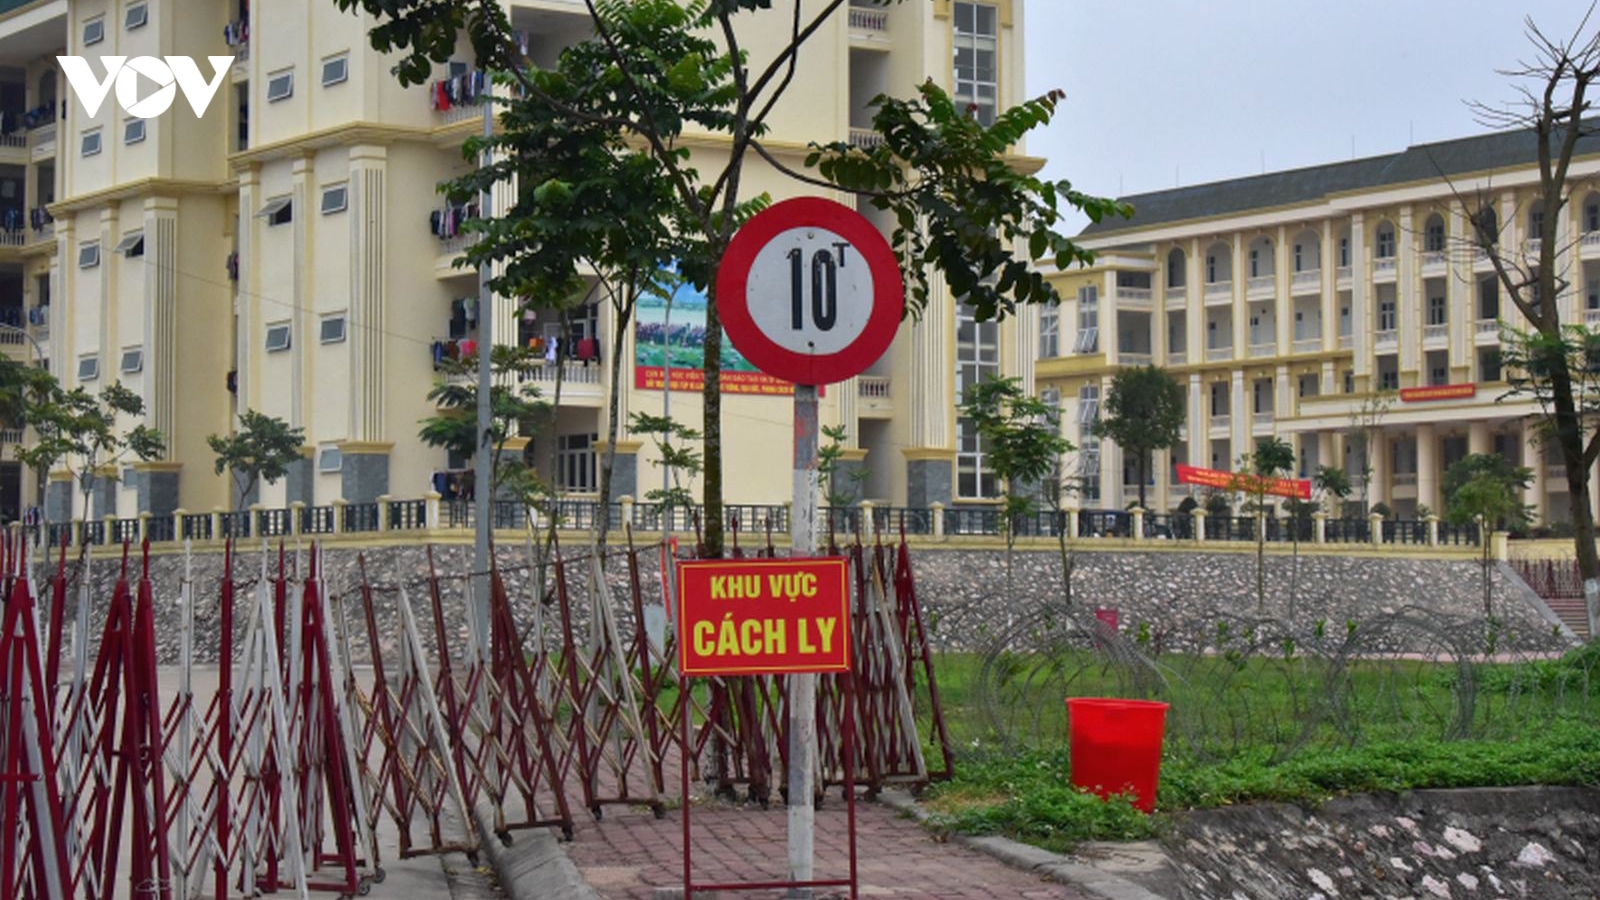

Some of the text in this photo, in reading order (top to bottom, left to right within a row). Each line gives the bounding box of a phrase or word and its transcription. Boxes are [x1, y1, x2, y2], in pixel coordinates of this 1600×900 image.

[710, 571, 818, 602] KHU VỰC
[693, 612, 837, 657] CÁCH LY
